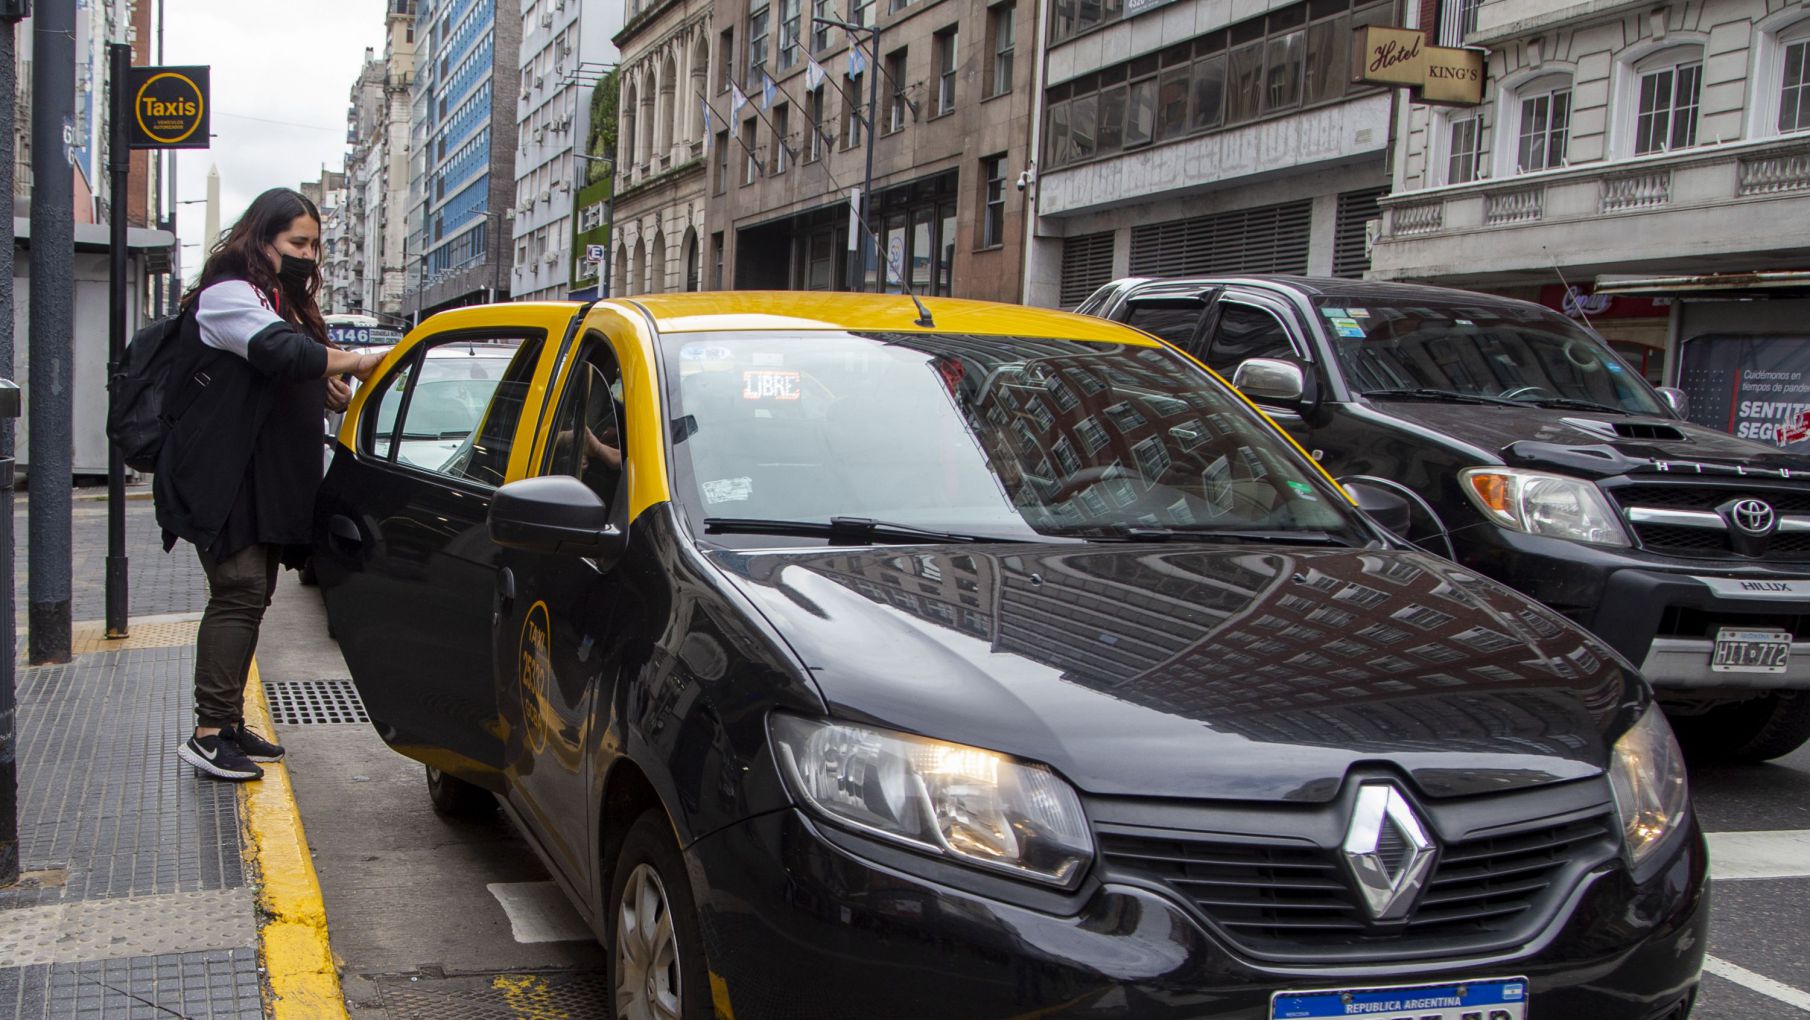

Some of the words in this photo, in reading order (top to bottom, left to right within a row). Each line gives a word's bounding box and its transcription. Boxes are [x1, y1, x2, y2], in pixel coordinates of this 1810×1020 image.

[1370, 35, 1420, 72] Hotel
[1429, 65, 1478, 81] KING'S
[142, 97, 196, 116] Taxis
[592, 247, 601, 259] E
[336, 329, 369, 342] 146
[1743, 369, 1790, 380] Cuidémonos
[745, 375, 798, 397] LIBRE
[1742, 383, 1771, 392] tiempos
[1772, 383, 1782, 392] de
[1740, 581, 1793, 592] HILUX
[529, 620, 546, 652] TAXI
[1757, 643, 1788, 666] 772
[1345, 1001, 1401, 1014] REPUBLICA
[1404, 996, 1461, 1010] ARGENTINA
